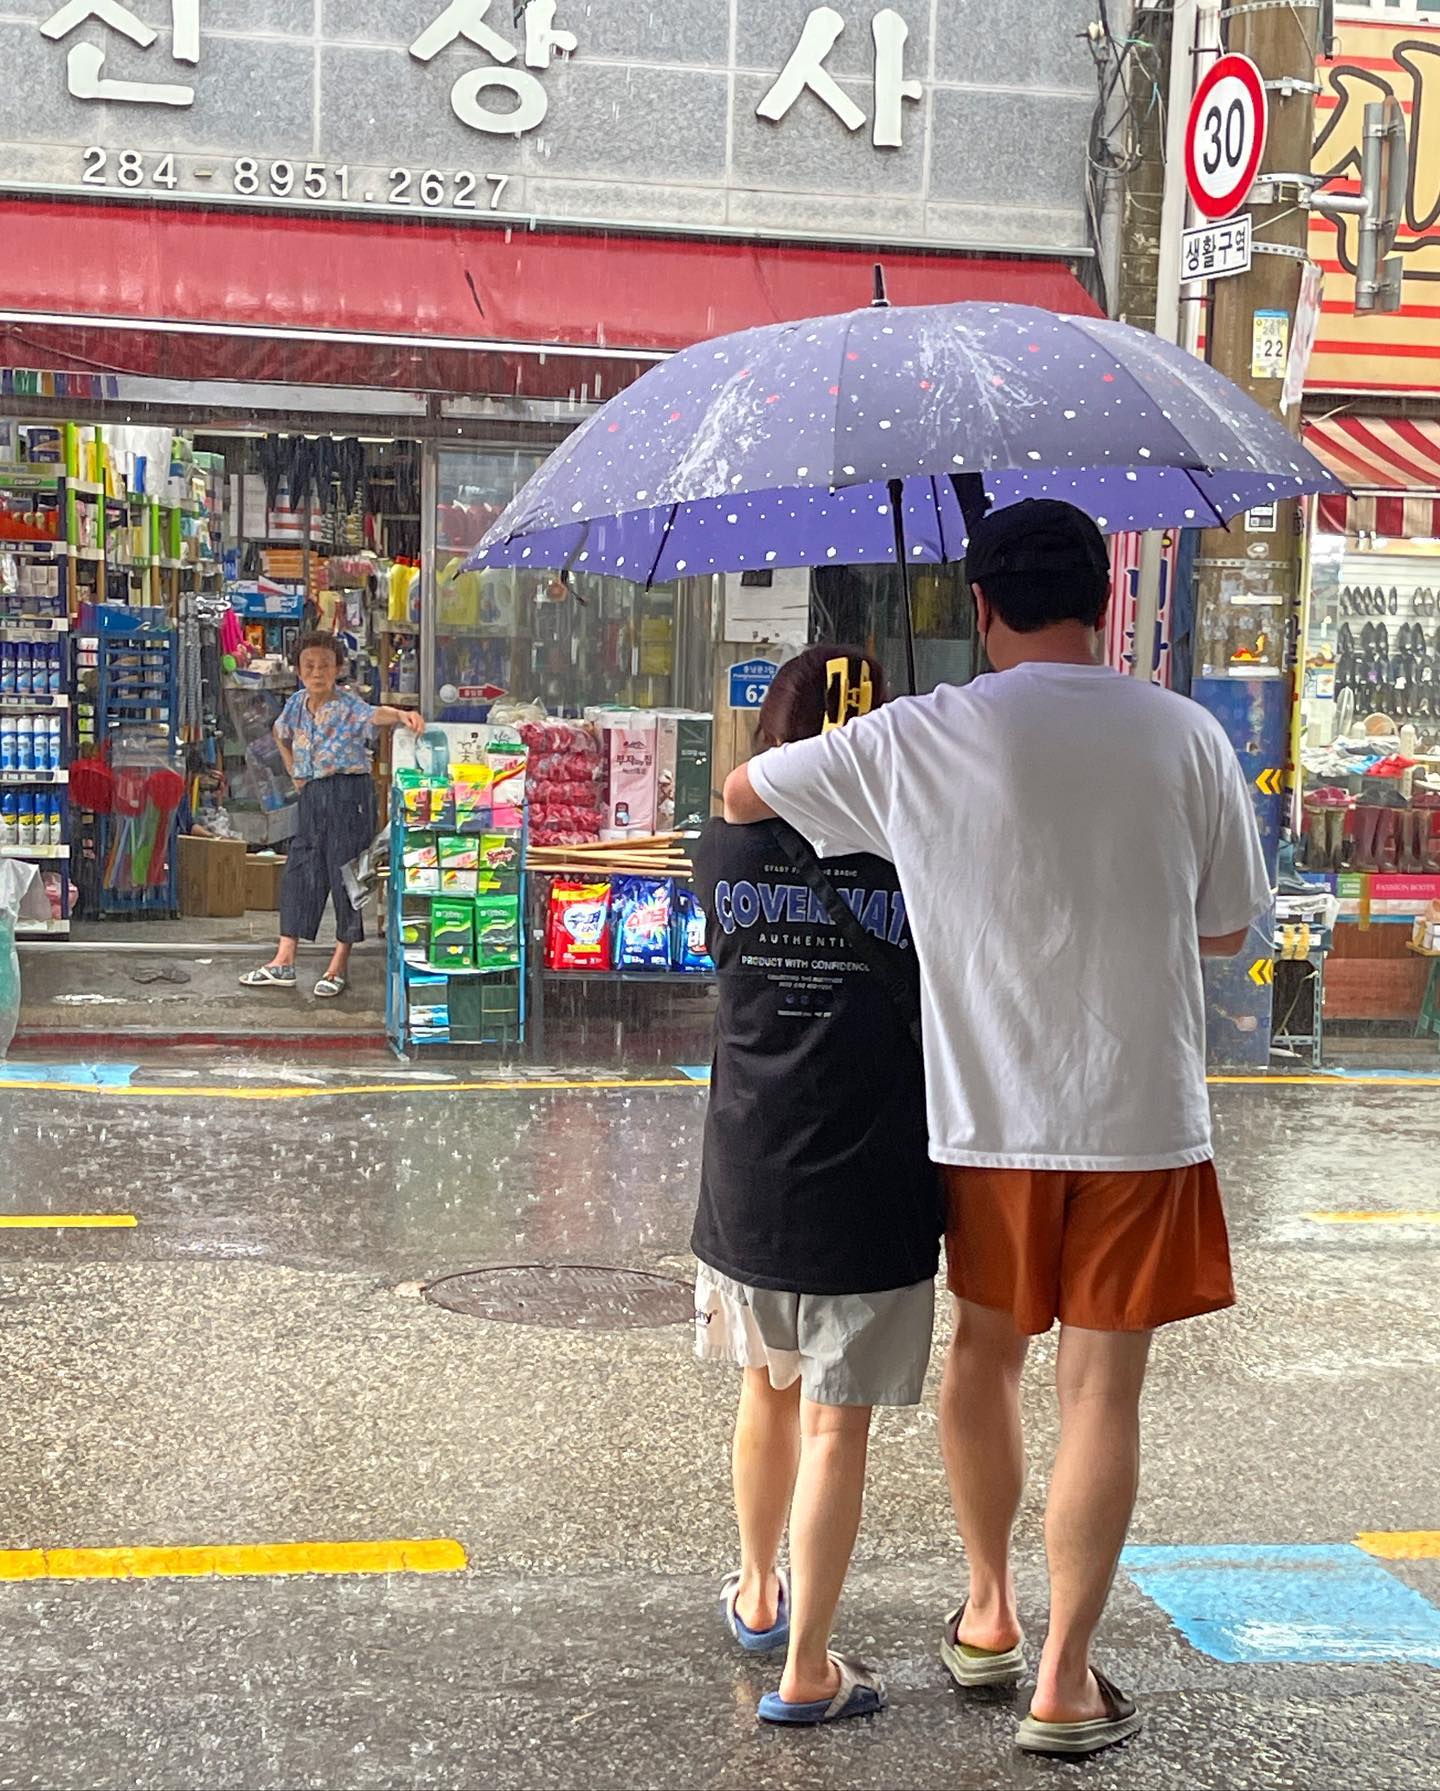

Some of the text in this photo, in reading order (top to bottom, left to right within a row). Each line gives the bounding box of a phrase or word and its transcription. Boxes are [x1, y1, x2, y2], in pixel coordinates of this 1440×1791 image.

[1202, 97, 1246, 175] 30
[1184, 226, 1247, 272] 생활구역
[1264, 339, 1284, 358] 22
[745, 684, 769, 704] 62
[758, 933, 853, 948] AUTHENTI
[741, 955, 783, 967] PRODUCT
[784, 958, 809, 969] WITH
